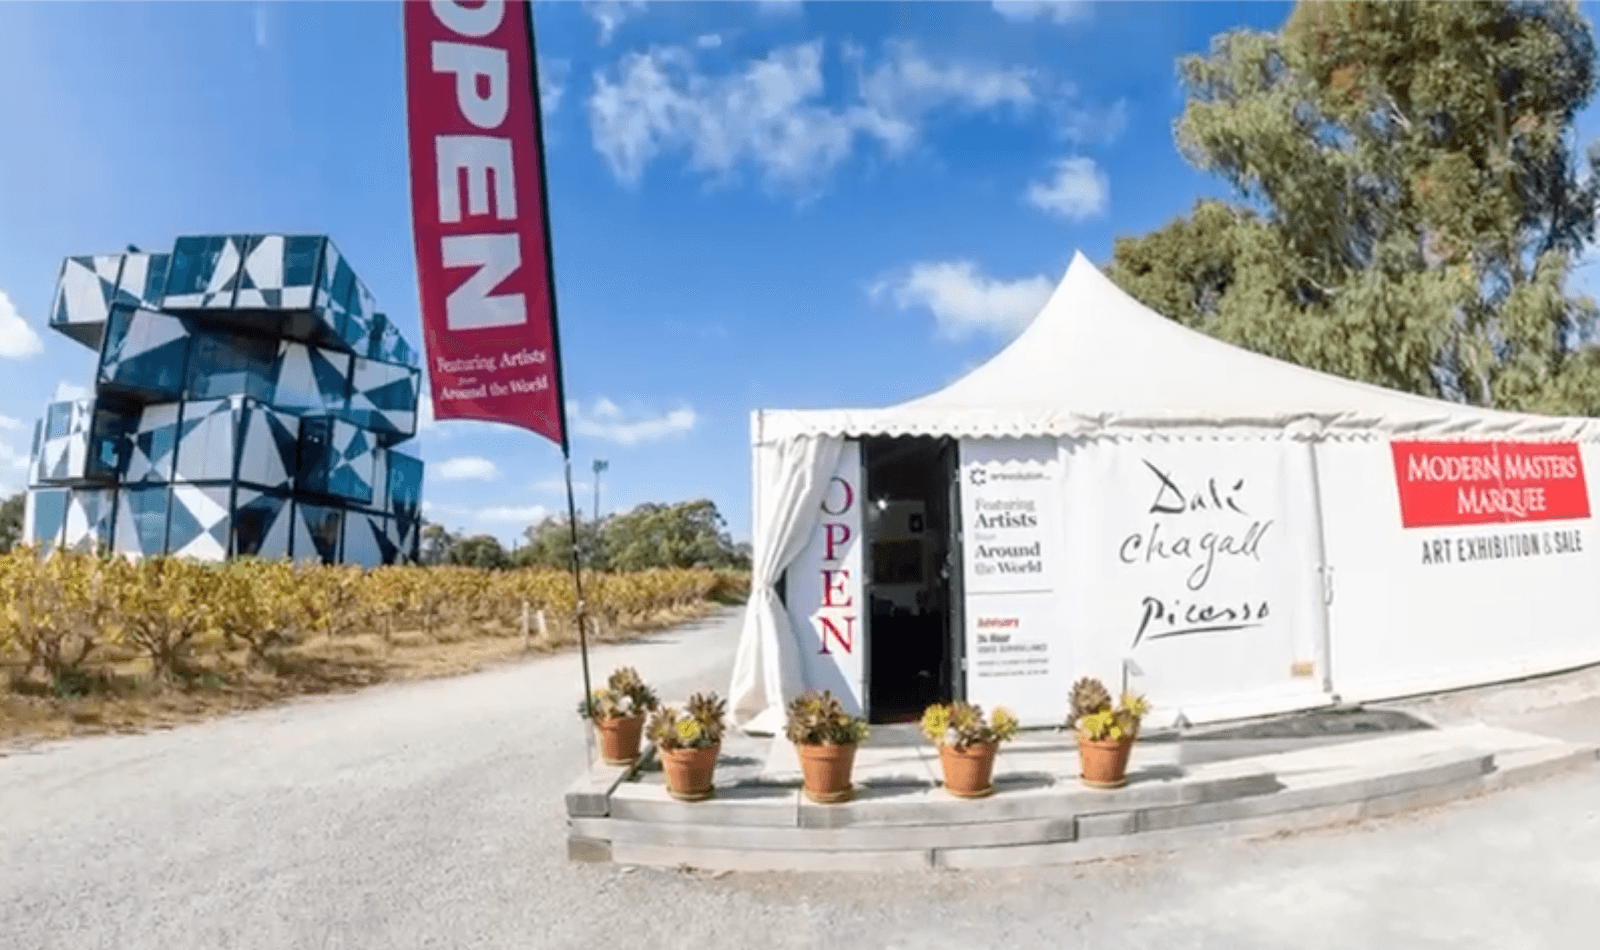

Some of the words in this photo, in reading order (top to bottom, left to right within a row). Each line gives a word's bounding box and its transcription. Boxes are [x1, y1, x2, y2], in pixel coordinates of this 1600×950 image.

[436, 353, 498, 373] Featuring
[500, 347, 547, 369] Artists
[440, 382, 487, 401] Around
[489, 381, 508, 398] the
[509, 374, 549, 394] World
[1408, 453, 1500, 482] MODERN
[1504, 454, 1577, 480] MASTERS
[975, 497, 1036, 512] Featuring
[1457, 486, 1547, 518] MARQUEE
[974, 511, 1038, 529] Artists
[974, 541, 1042, 558] Around
[1421, 538, 1452, 565] ART
[1457, 533, 1541, 563] EXHIBITION
[1553, 529, 1583, 555] SALE
[818, 476, 856, 655] OPEN
[974, 561, 996, 575] the
[997, 560, 1042, 574] World
